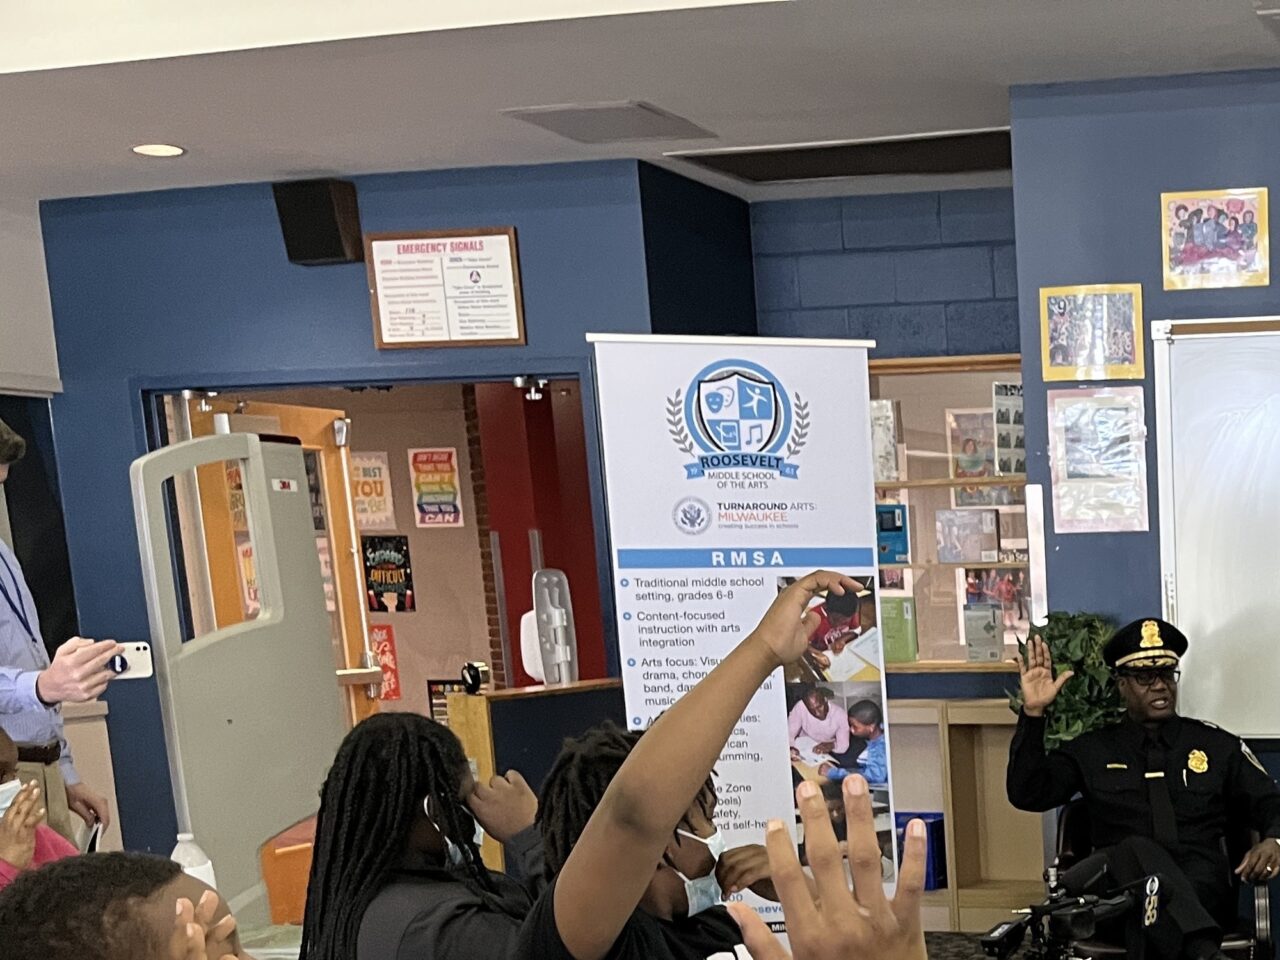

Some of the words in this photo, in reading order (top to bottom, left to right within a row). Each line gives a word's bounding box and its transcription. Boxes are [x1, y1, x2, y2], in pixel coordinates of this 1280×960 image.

[397, 242, 447, 255] EMERGENCY
[449, 240, 484, 252] SIGNALS
[700, 454, 783, 469] ROOSEVELT
[362, 466, 382, 479] BEST
[708, 471, 740, 480] MIDDLE
[742, 471, 776, 480] SCHOOL
[352, 480, 384, 497] YOU
[717, 481, 728, 489] OF
[748, 481, 768, 489] ARTS
[717, 502, 788, 511] TURNAROUND
[425, 513, 455, 524] CAN
[718, 513, 788, 522] MILWAUKEE
[633, 577, 689, 588] Traditional
[692, 577, 727, 588] middle
[729, 576, 765, 587] school
[635, 591, 674, 603] setting,
[677, 590, 714, 603] grades
[716, 590, 734, 600] 6-8
[636, 610, 726, 622] Content-focused
[638, 624, 694, 635] instruction
[696, 623, 718, 633] with
[720, 623, 741, 633] arts
[639, 637, 696, 649] integration
[641, 657, 663, 667] Arts
[665, 657, 698, 667] focus:
[642, 671, 679, 681] drama,
[643, 683, 674, 693] band,
[726, 783, 752, 793] Zone
